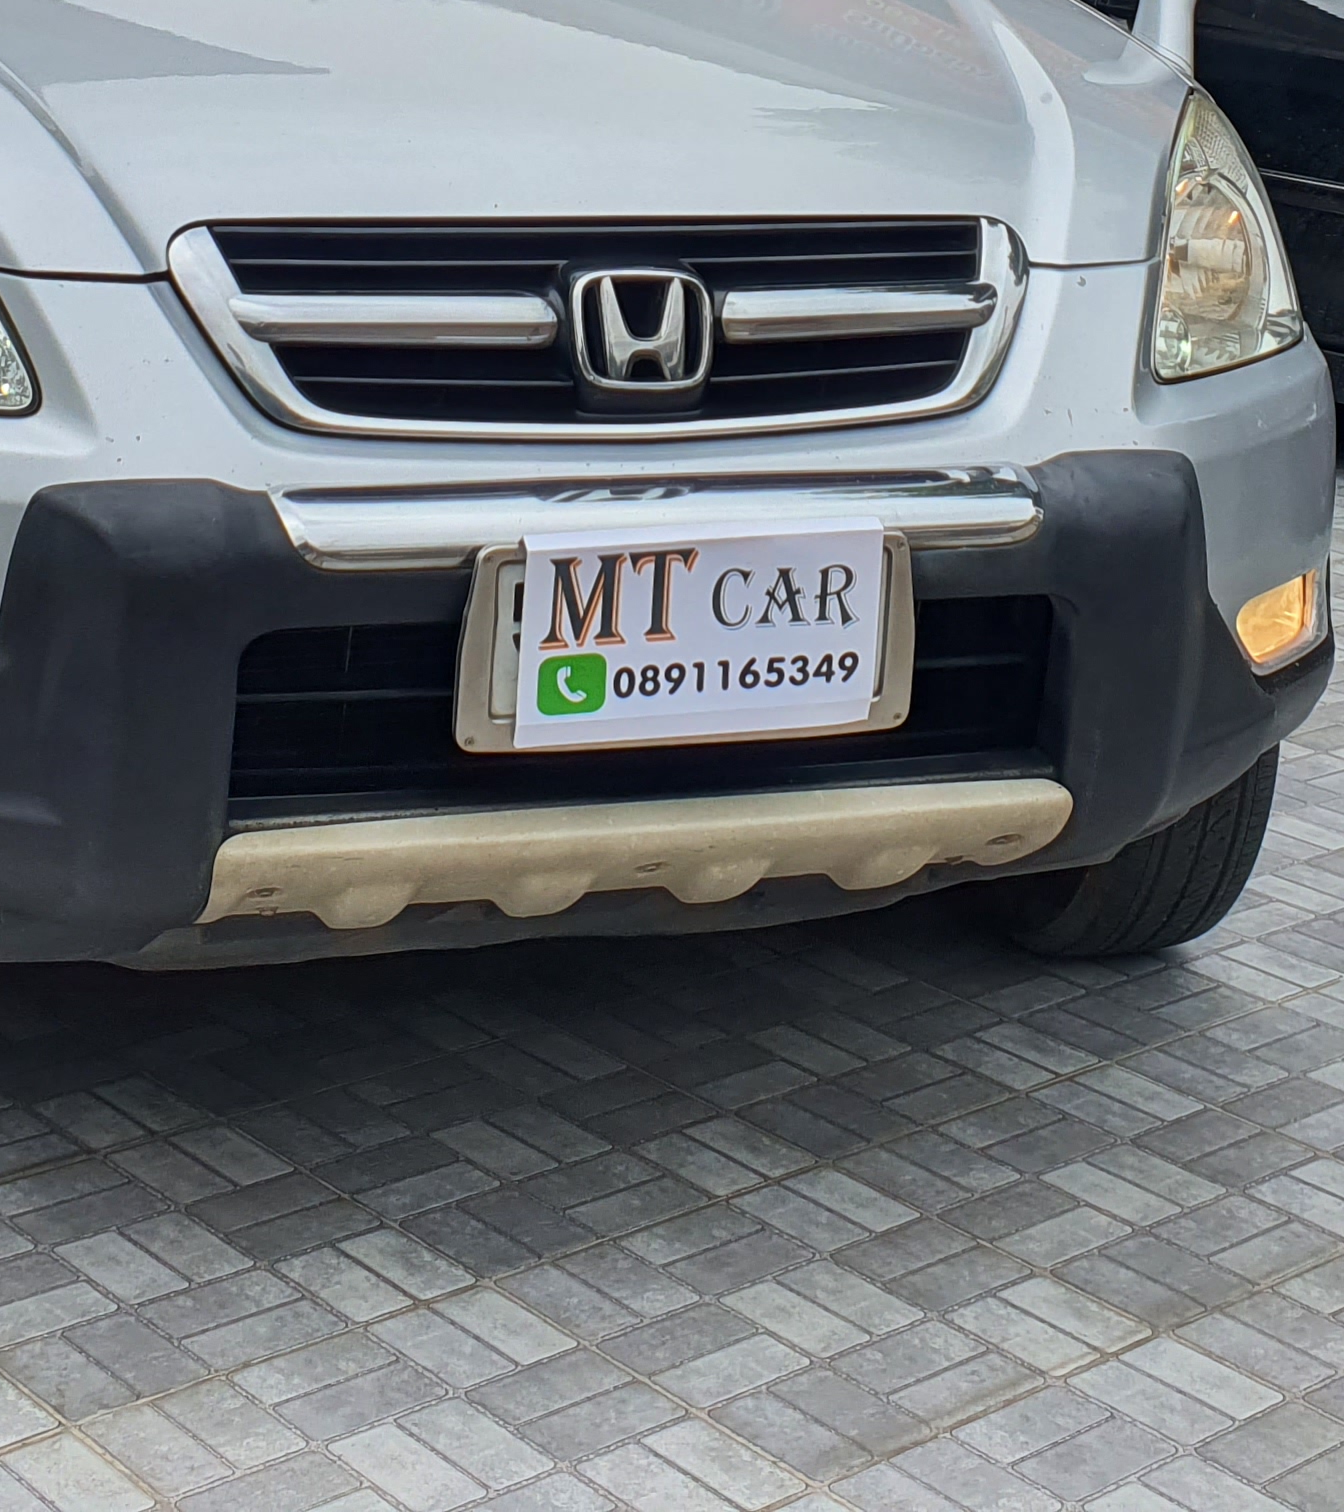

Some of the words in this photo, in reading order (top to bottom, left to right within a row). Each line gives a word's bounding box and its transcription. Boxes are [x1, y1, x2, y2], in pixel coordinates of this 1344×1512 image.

[537, 547, 699, 651] MT
[711, 563, 859, 631] CAR
[612, 650, 860, 699] 0891165349
